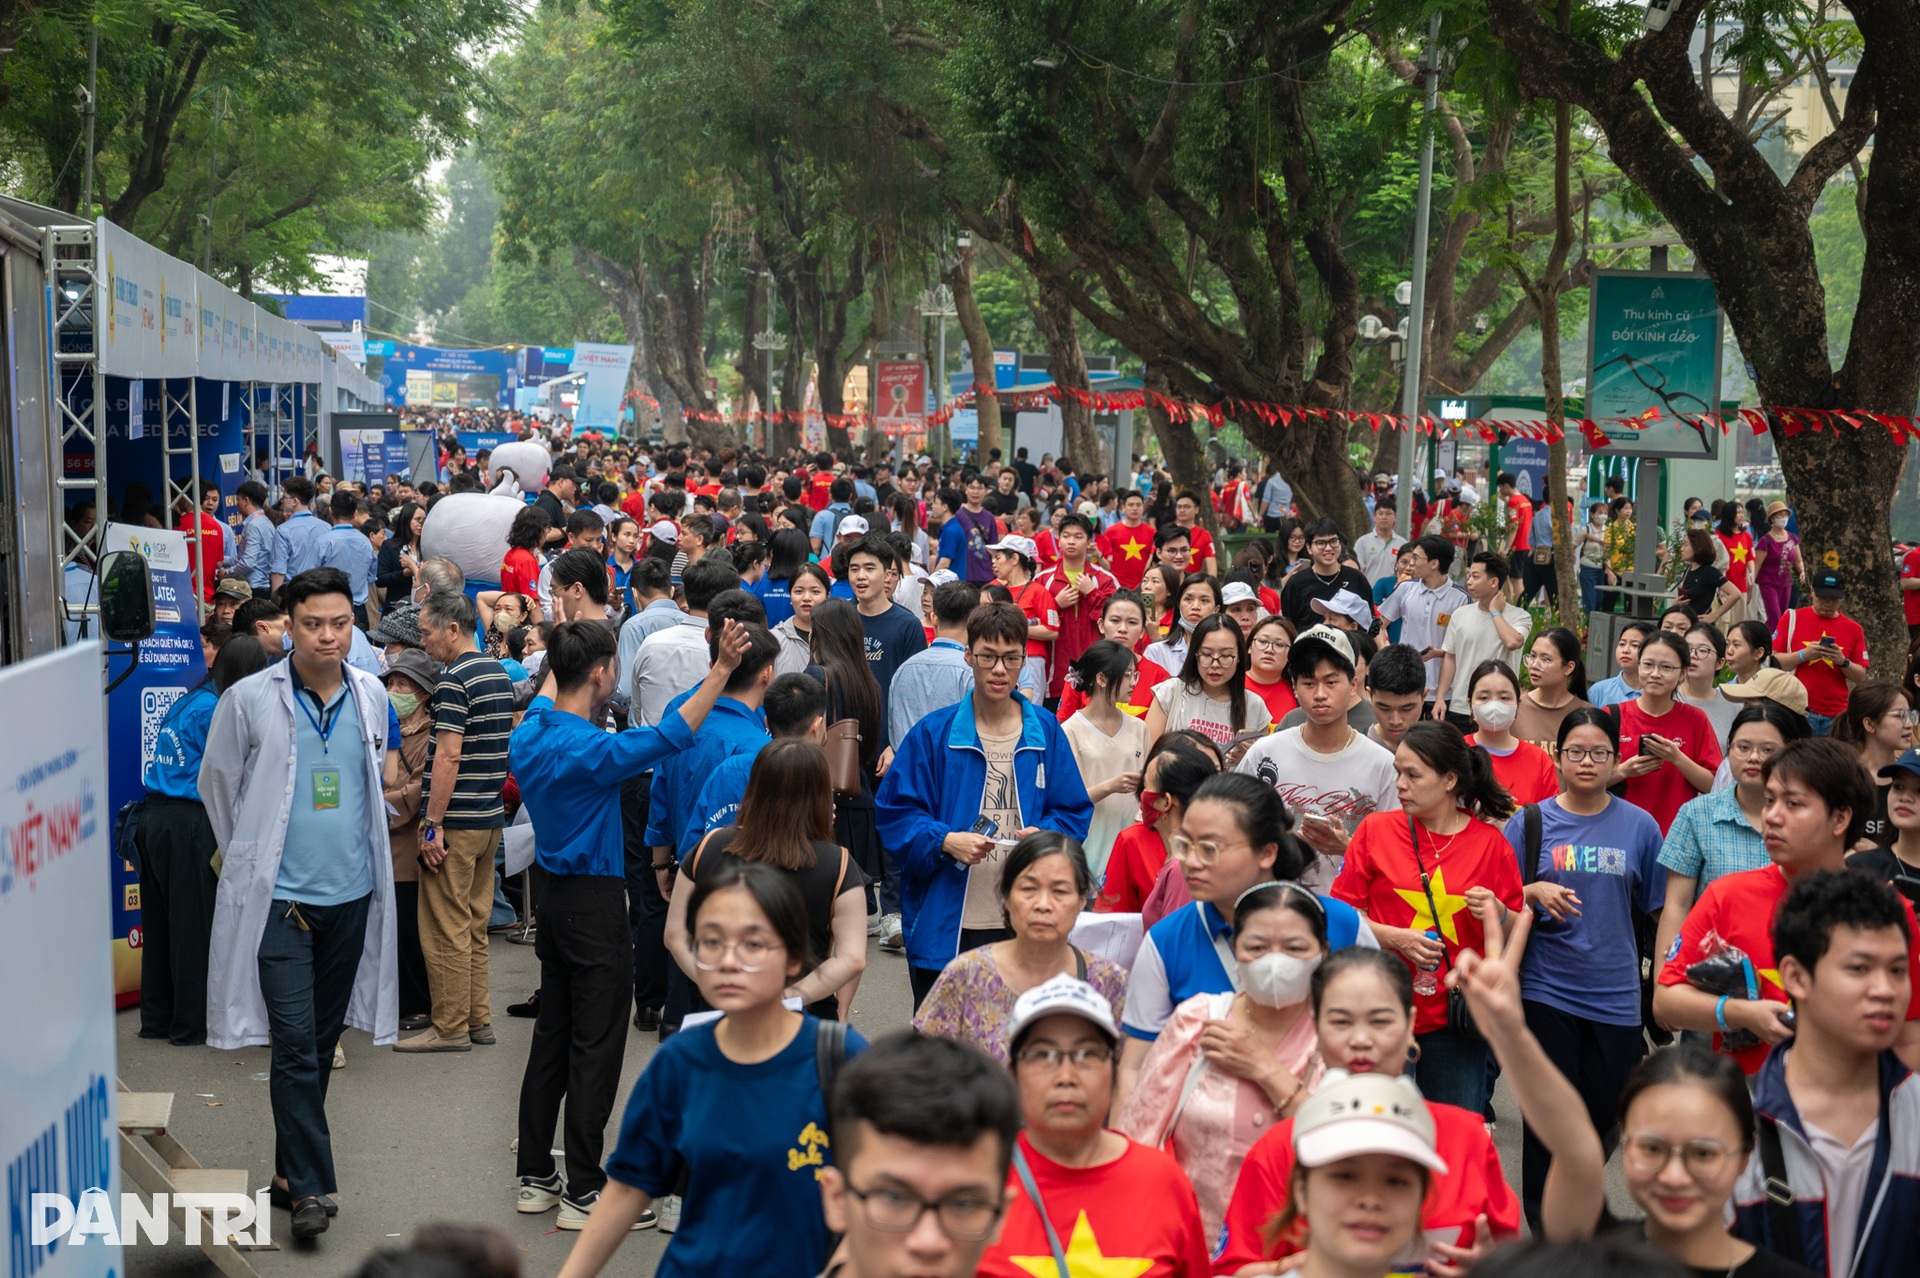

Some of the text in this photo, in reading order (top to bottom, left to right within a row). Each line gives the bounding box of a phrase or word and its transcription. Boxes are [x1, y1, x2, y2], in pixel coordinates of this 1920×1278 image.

[1624, 309, 1690, 321] Thu kính cũ
[1637, 329, 1665, 342] KÍNH
[1668, 328, 1699, 343] dẻo
[544, 351, 567, 359] START
[600, 356, 618, 364] NAM
[66, 459, 81, 468] 56
[154, 653, 169, 665] DỤNG
[170, 653, 182, 666] DỊCH
[182, 653, 189, 666] VỤ
[1274, 782, 1377, 817] New York
[709, 806, 728, 823] VIỆN
[10, 799, 44, 892] VIỆT
[46, 795, 82, 864] NAM
[1551, 843, 1598, 873] WAVE
[128, 895, 138, 907] 03
